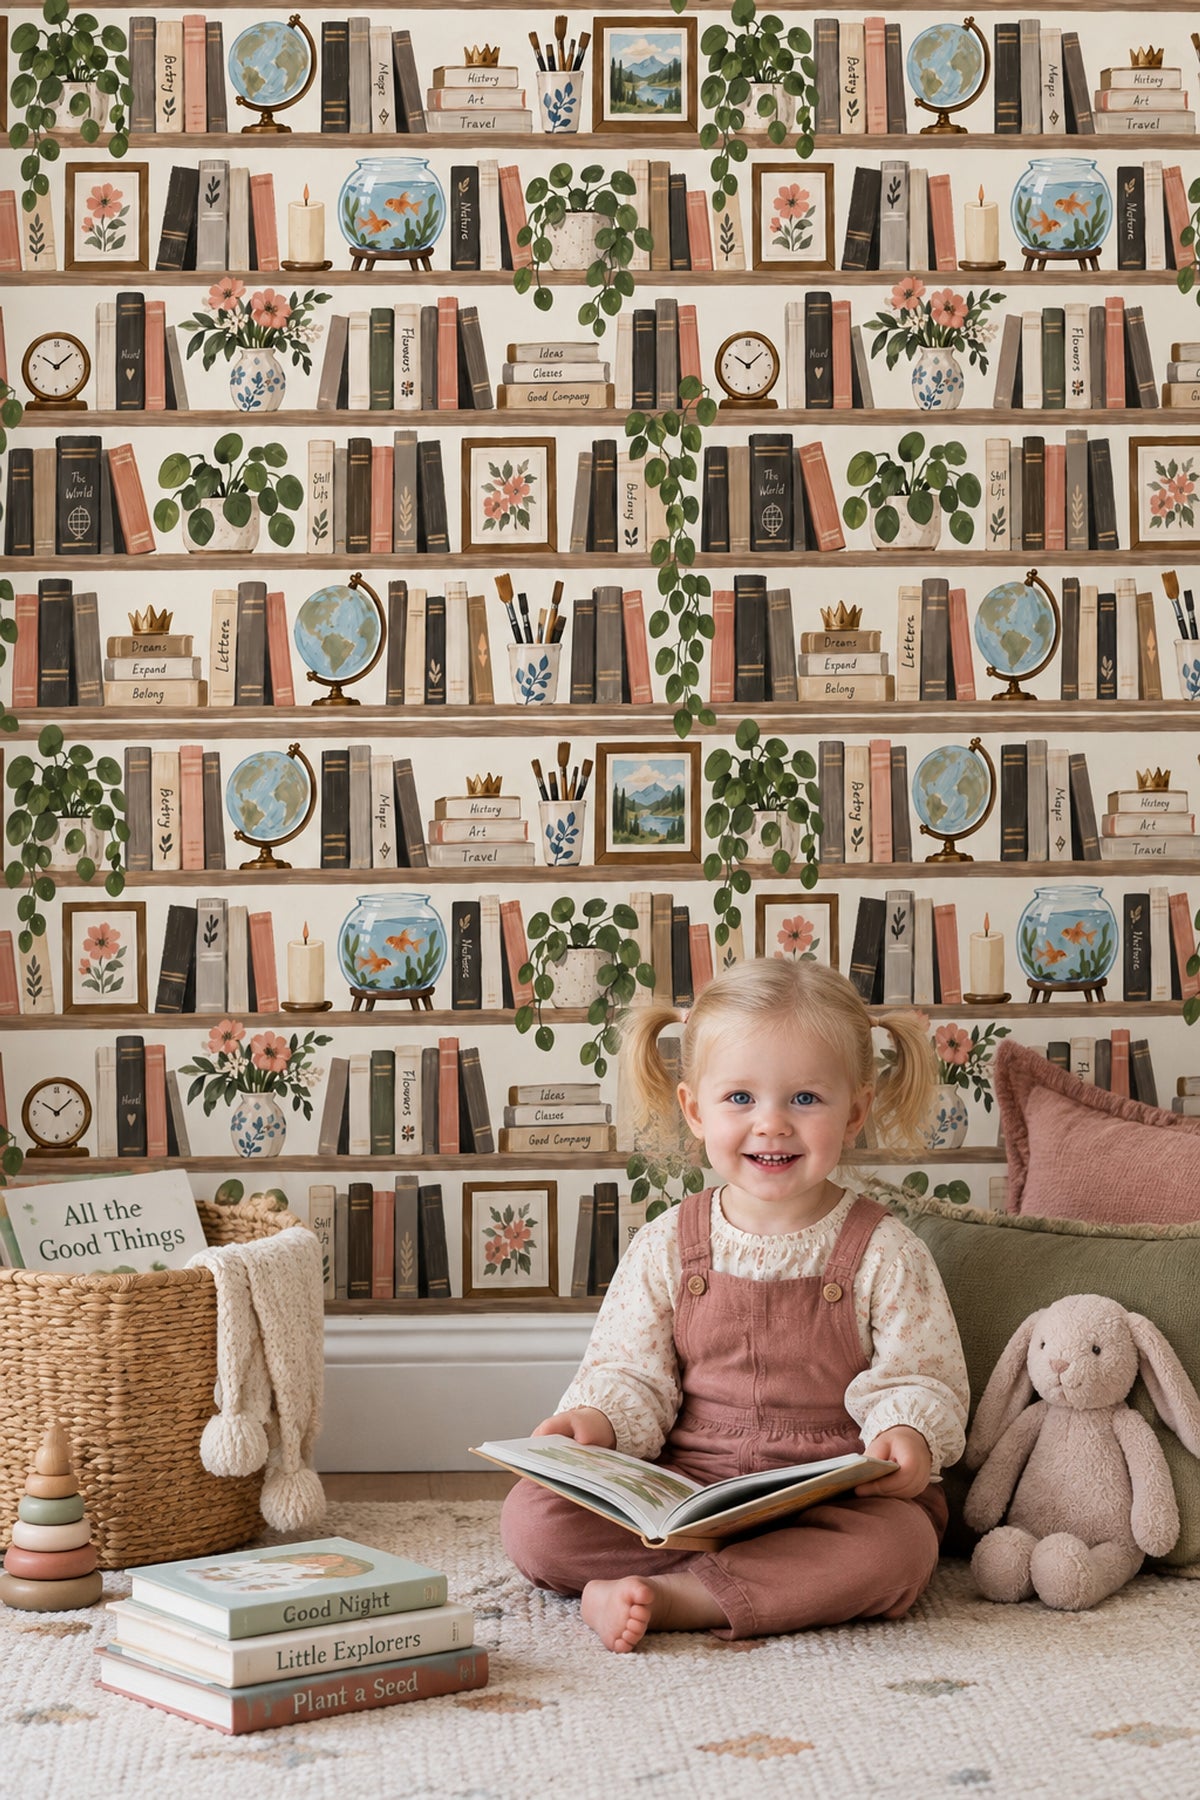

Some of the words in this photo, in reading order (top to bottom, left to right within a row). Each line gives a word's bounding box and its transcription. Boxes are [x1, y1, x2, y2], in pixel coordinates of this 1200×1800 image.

[467, 73, 499, 87] History
[467, 94, 484, 105] Art
[1133, 95, 1149, 105] Art
[460, 117, 495, 129] Travel
[1126, 118, 1160, 129] Travel
[539, 347, 563, 359] Ideas
[527, 390, 549, 402] Good
[552, 391, 590, 406] Company
[764, 469, 778, 480] The
[760, 484, 784, 496] World
[131, 641, 167, 653] Dreams
[824, 637, 857, 648] Dreams
[132, 662, 166, 678] Expand
[824, 658, 857, 674] Expand
[132, 688, 164, 704] Belong
[825, 682, 855, 699] Belong
[1140, 819, 1156, 830] Art
[469, 826, 486, 837] Art
[461, 849, 498, 862] Travel
[540, 1090, 565, 1101] Ideas
[64, 1202, 98, 1226] All
[103, 1200, 143, 1221] the
[39, 1233, 102, 1261] Good
[104, 1228, 185, 1252] Things
[283, 1600, 331, 1623] Good
[339, 1592, 391, 1614] Night
[277, 1645, 326, 1671] Little
[334, 1634, 421, 1661] Explorers
[294, 1686, 348, 1714] Plant
[355, 1688, 366, 1702] a
[374, 1671, 418, 1698] Seed
